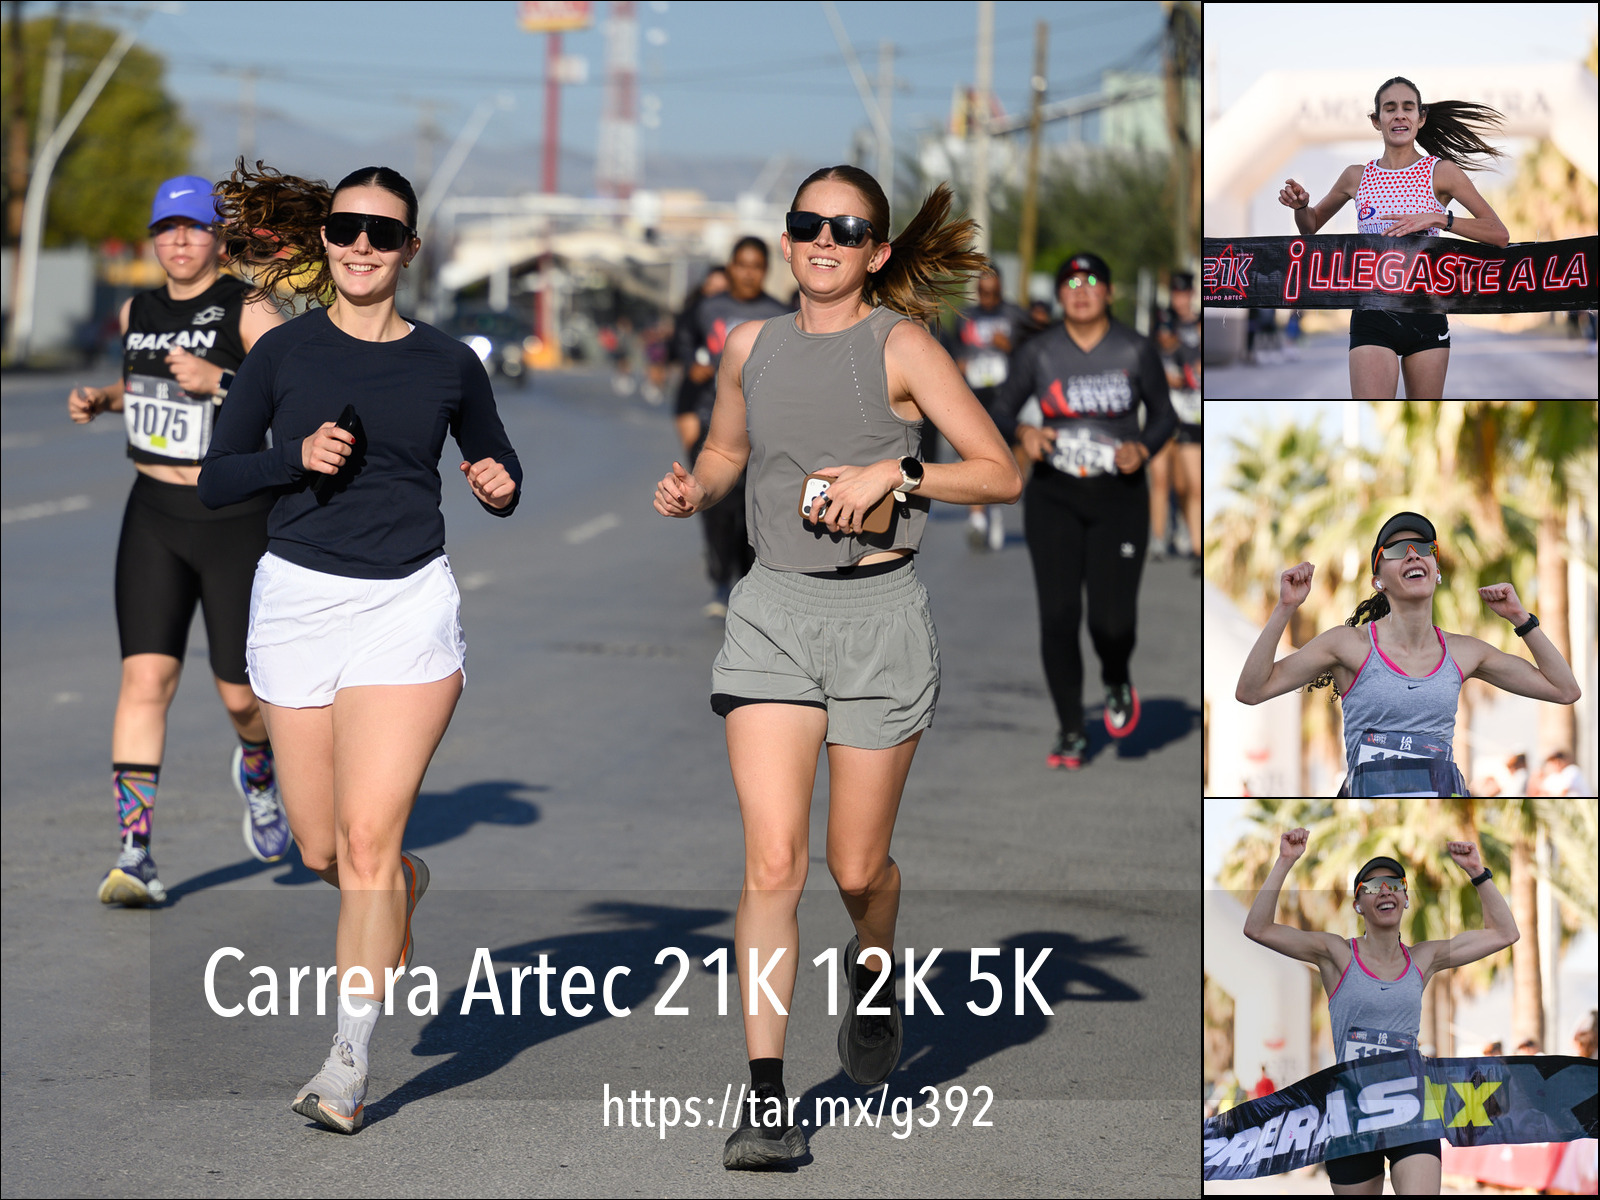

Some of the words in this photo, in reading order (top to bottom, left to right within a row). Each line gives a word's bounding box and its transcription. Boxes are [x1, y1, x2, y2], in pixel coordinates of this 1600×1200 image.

[1204, 257, 1254, 287] 21K
[1285, 241, 1506, 300] ¡LLEGASTE
[1507, 257, 1536, 291] A
[1543, 253, 1588, 290] LA
[126, 330, 217, 350] RAKAN
[130, 402, 188, 442] 1075
